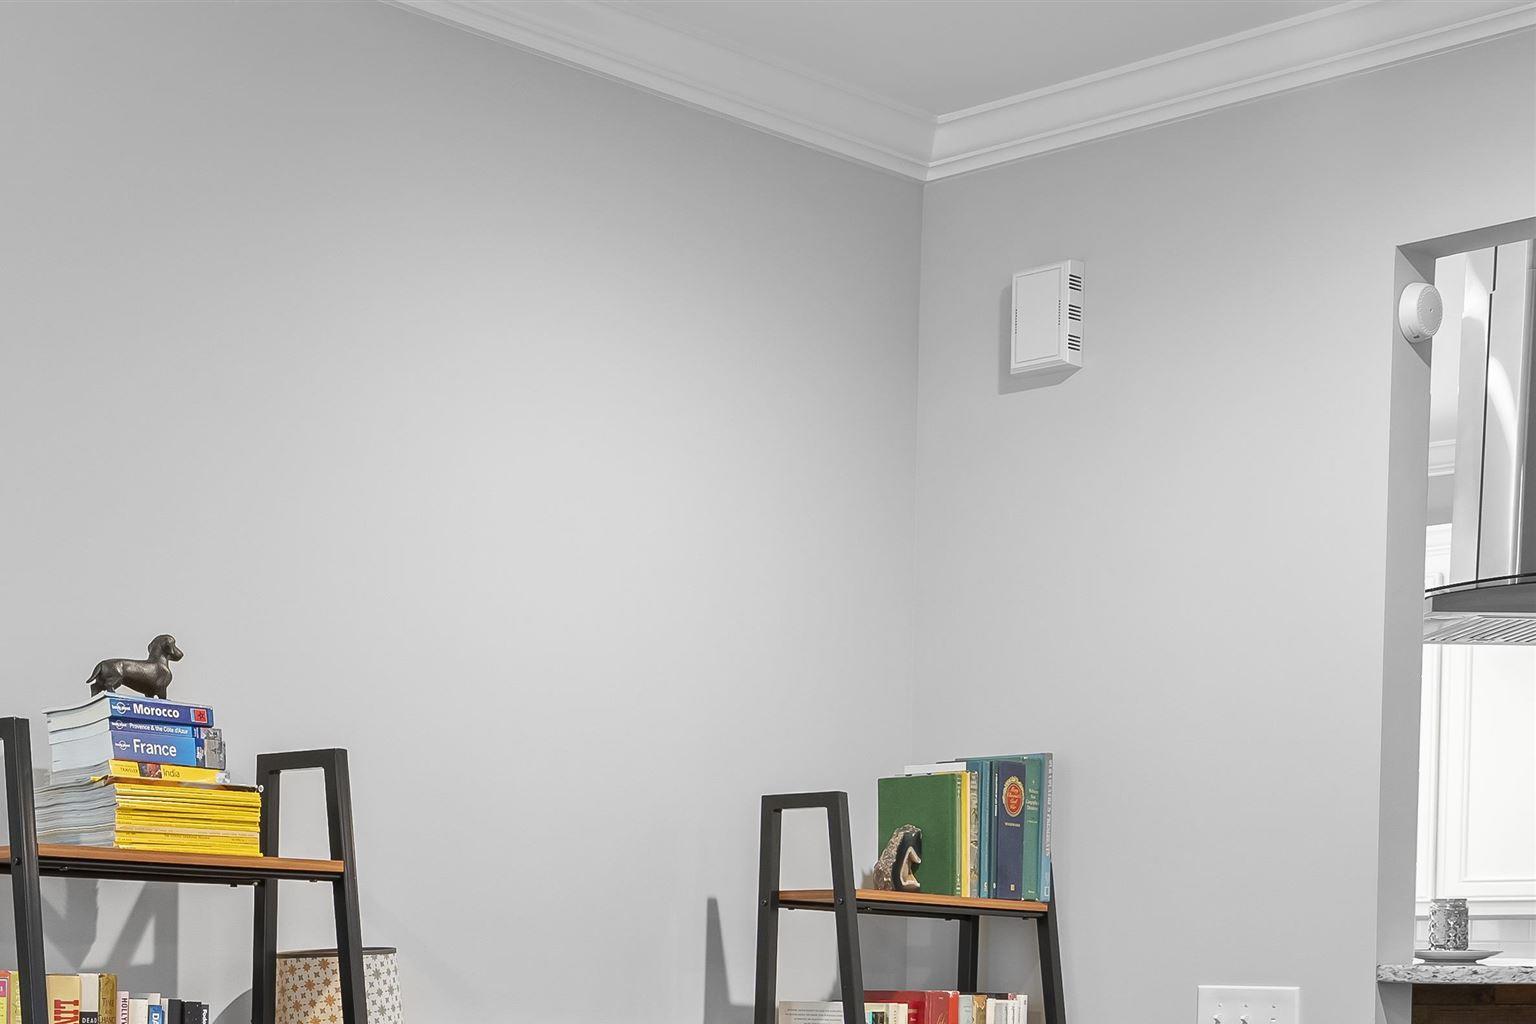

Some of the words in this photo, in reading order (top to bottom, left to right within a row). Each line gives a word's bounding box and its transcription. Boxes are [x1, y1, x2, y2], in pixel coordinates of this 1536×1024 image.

[133, 703, 180, 718] Morocco
[129, 723, 150, 731] Provence
[133, 739, 177, 757] France
